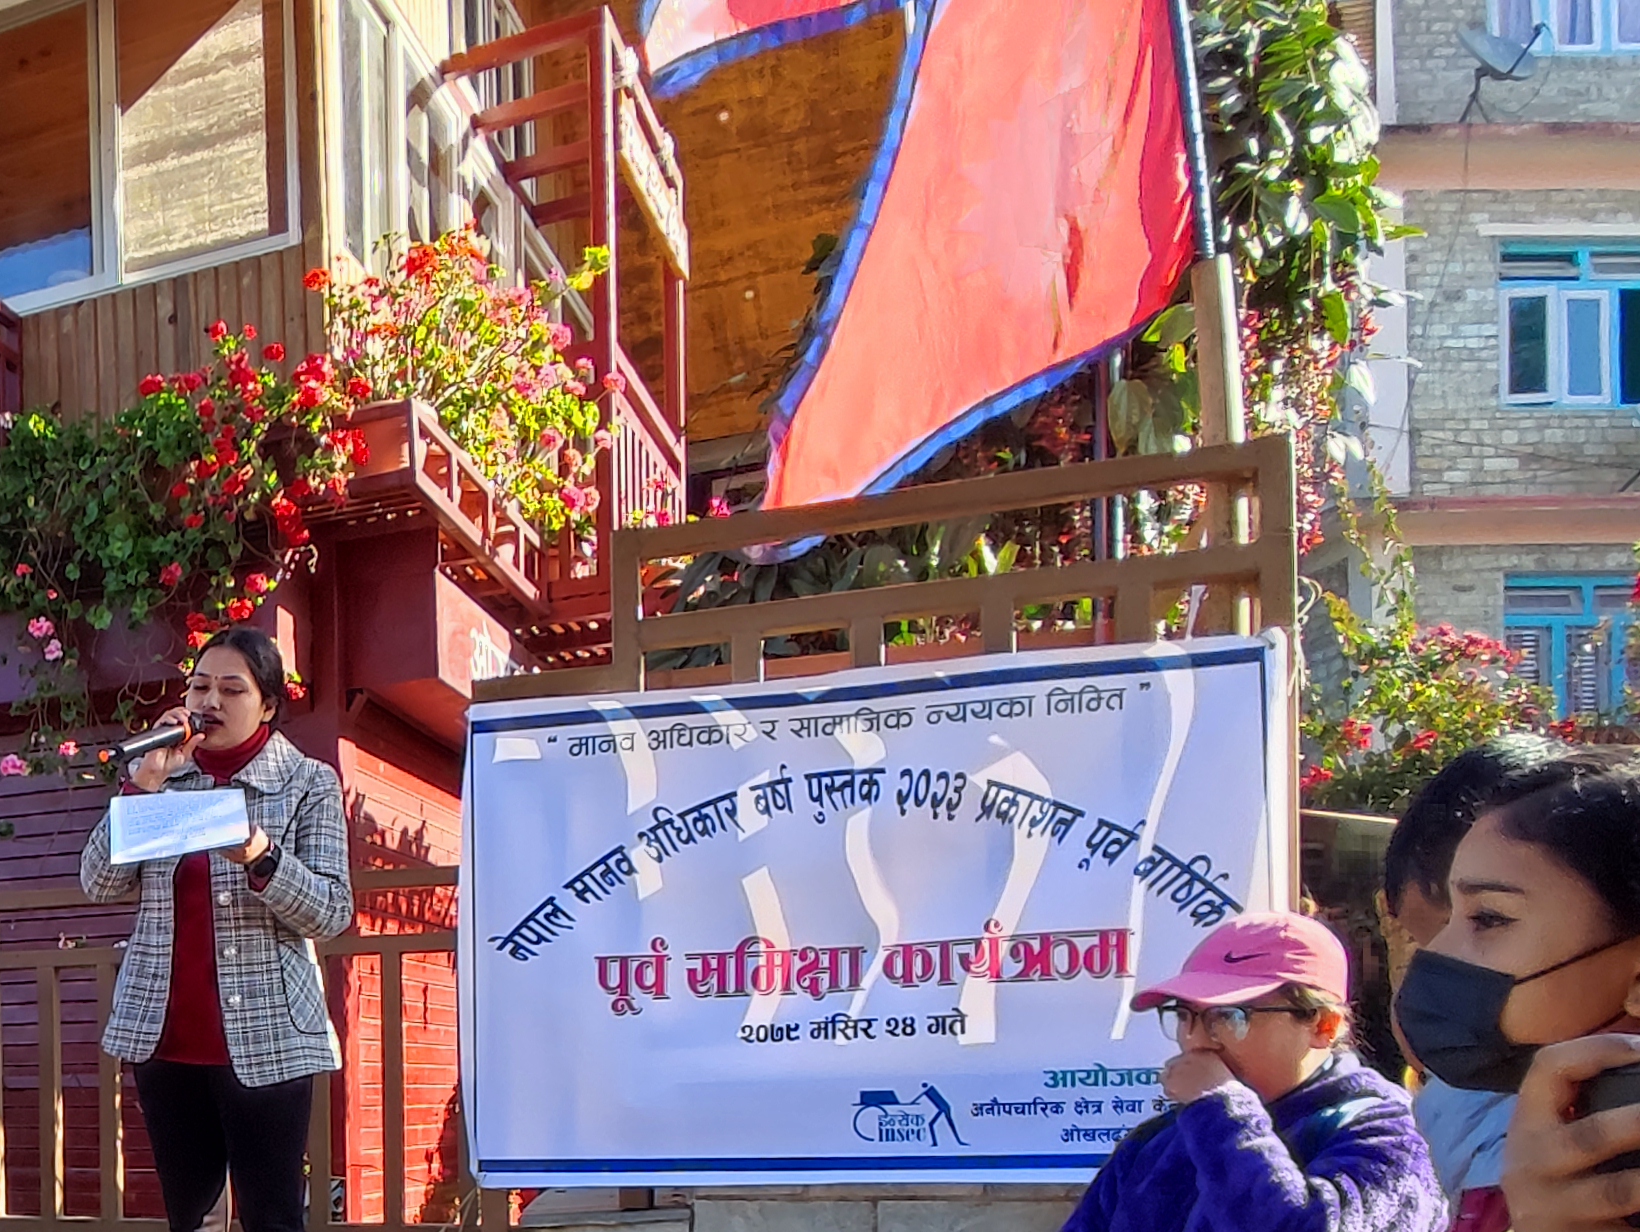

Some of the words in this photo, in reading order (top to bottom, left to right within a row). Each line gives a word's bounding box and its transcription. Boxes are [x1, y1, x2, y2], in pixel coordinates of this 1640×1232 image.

[568, 732, 637, 757] मानव
[647, 722, 754, 751] अधिकार
[759, 719, 779, 741] र
[789, 706, 916, 739] सामाजिक
[487, 895, 577, 961] नेपाल
[561, 844, 639, 904] मानव
[637, 791, 746, 864] अधिकार
[804, 766, 886, 824] पुस्तक
[895, 767, 968, 822] २०२३
[974, 778, 1086, 847] प्रकाशन
[1077, 817, 1146, 872] पूर्व
[684, 935, 867, 1002] समिक्षा
[740, 1022, 801, 1044] २०७९
[809, 1012, 878, 1042] मंसिर
[884, 1016, 917, 1038] २४
[927, 1008, 969, 1037] गते
[1074, 1097, 1104, 1117] क्षेत्र
[1112, 1095, 1145, 1117] सेवा
